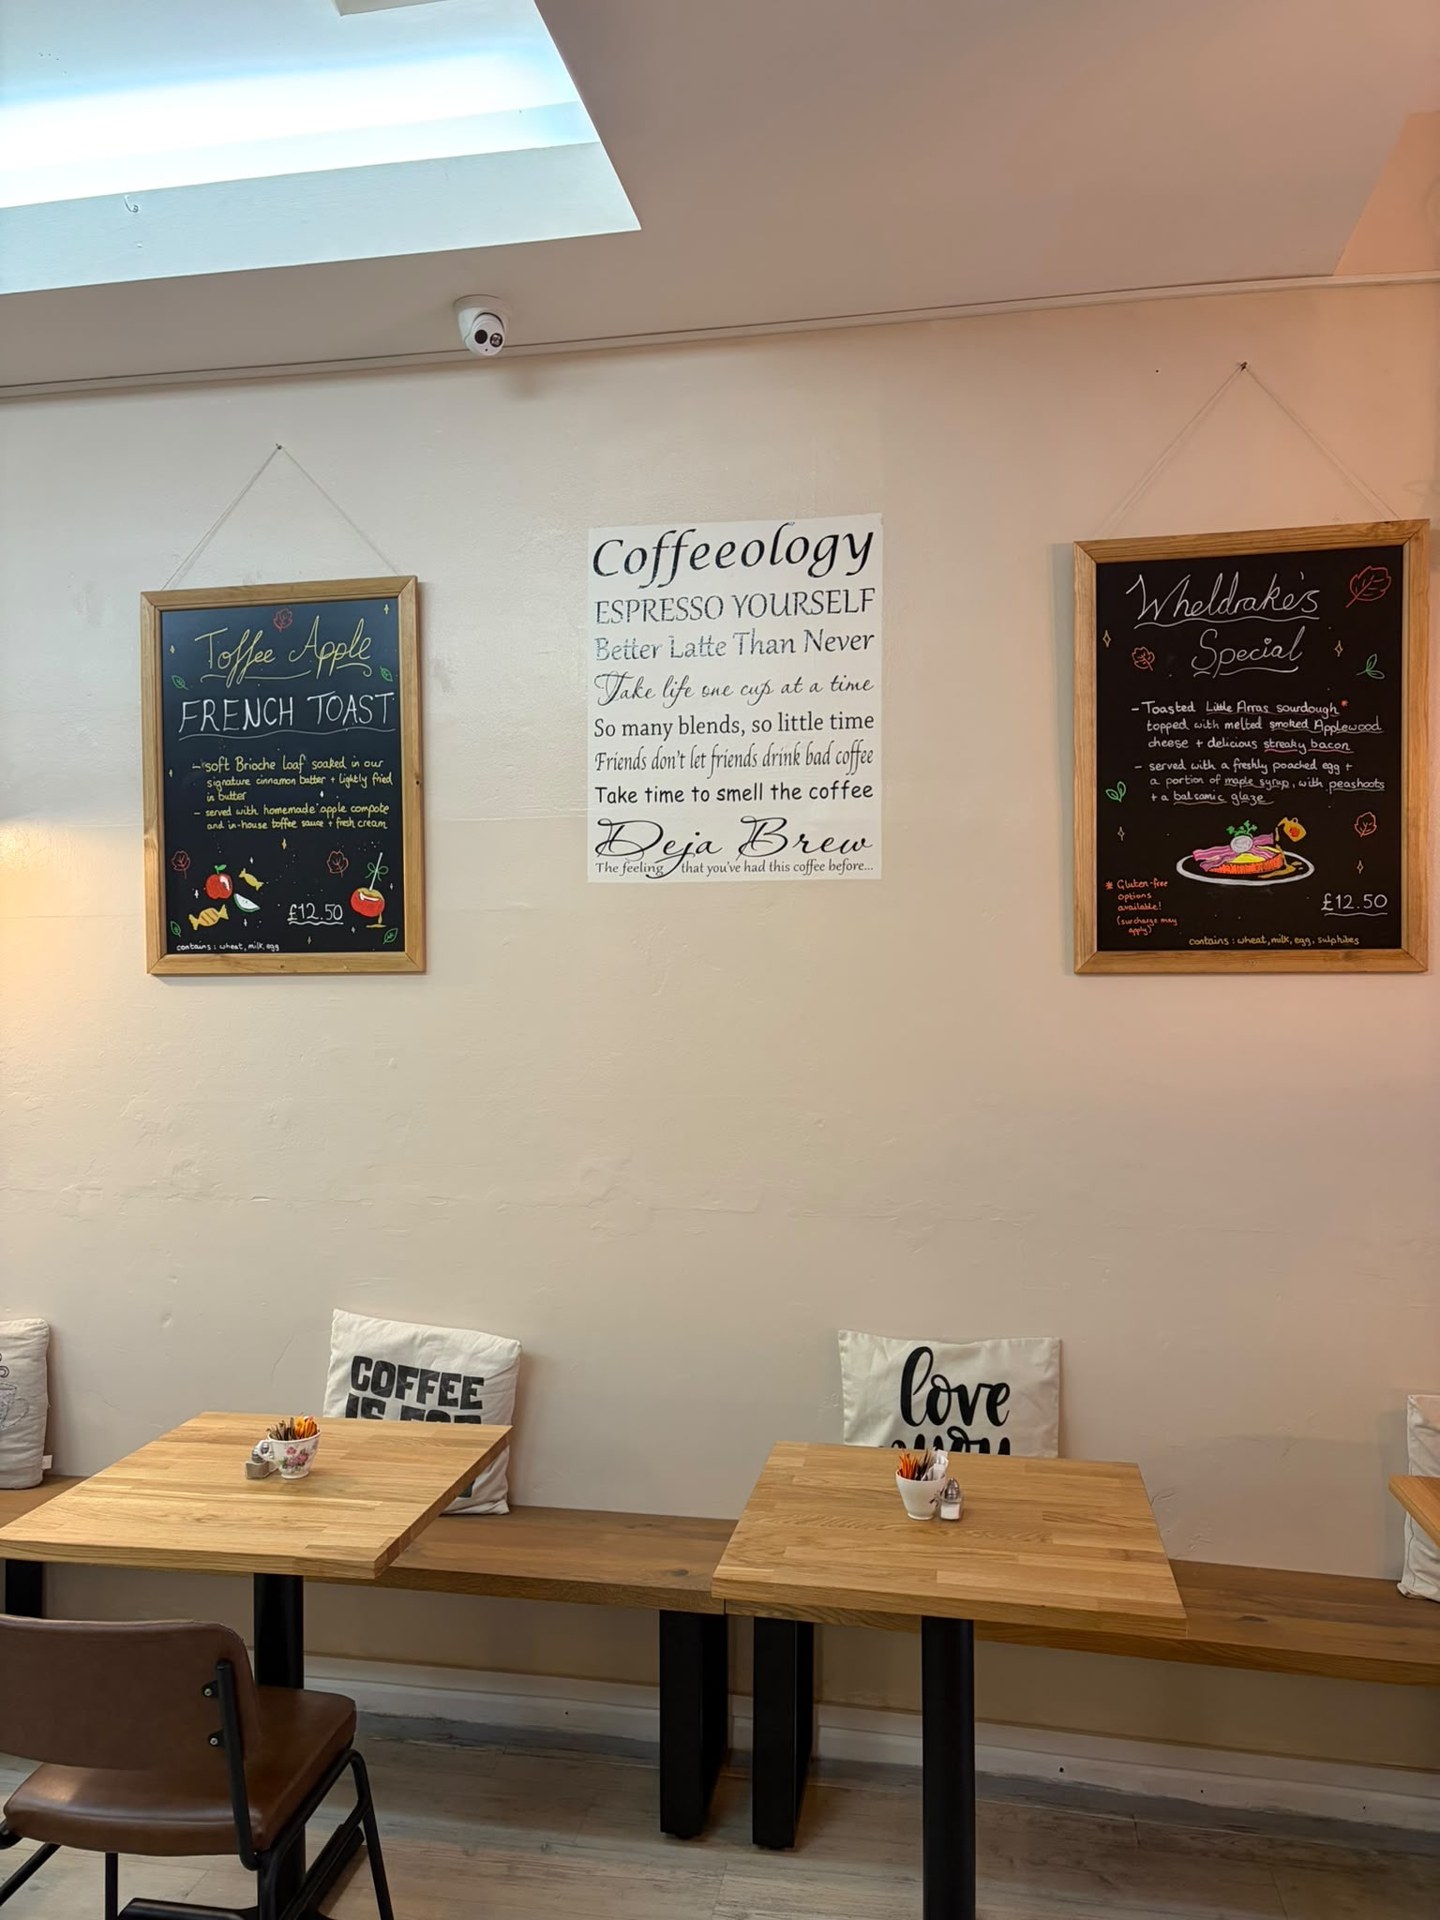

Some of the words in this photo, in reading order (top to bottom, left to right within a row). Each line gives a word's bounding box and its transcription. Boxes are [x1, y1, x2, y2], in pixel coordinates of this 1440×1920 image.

[592, 521, 874, 589] Coffeeology
[595, 595, 724, 624] ESPRESSO
[731, 587, 876, 619] YOURSELF
[1126, 571, 1320, 620] Wheldrake's
[195, 627, 276, 688] Toffee
[288, 615, 371, 679] Apple
[594, 637, 662, 661] Better
[669, 635, 727, 658] Latte
[733, 628, 796, 655] Than
[803, 628, 874, 653] Never
[1191, 626, 1306, 678] Special
[594, 670, 655, 706] Take
[662, 674, 695, 709] life
[701, 686, 734, 697] one
[740, 679, 773, 706] cup
[781, 676, 803, 694] at
[809, 683, 823, 693] a
[830, 675, 874, 692] time
[178, 697, 293, 733] FRENCH
[307, 691, 395, 726] TOAST
[1141, 700, 1196, 714] Toasted
[1206, 700, 1233, 713] Little
[1237, 700, 1268, 713] Arras
[594, 718, 616, 737] So
[622, 721, 673, 741] many
[678, 714, 746, 737] blends,
[751, 718, 772, 733] so
[778, 711, 824, 732] little
[829, 712, 874, 730] time
[1147, 718, 1190, 735] topped
[1194, 719, 1219, 729] with
[1225, 716, 1262, 730] melted
[1269, 718, 1309, 729] smoked
[1314, 715, 1382, 736] Applewood
[1148, 736, 1189, 748] cheese
[1207, 736, 1257, 749] delicious
[1263, 738, 1306, 755] streaky
[1311, 738, 1350, 750] bacon
[205, 756, 230, 773] soft
[235, 756, 276, 772] Brioche
[283, 754, 306, 773] loaf
[312, 756, 347, 770] soaked
[351, 755, 360, 768] in
[594, 746, 647, 772] Friends
[651, 746, 686, 771] don't
[690, 744, 706, 768] let
[706, 743, 758, 779] friends
[762, 742, 800, 767] drink
[805, 740, 831, 766] bad
[835, 739, 874, 775] coffee
[1149, 758, 1186, 771] served
[1191, 760, 1216, 770] with
[1233, 758, 1268, 774] freshly
[1273, 758, 1317, 773] poached
[1322, 762, 1340, 775] egg
[207, 776, 251, 792] signature
[256, 775, 296, 785] cinnamon
[299, 775, 326, 784] batter
[339, 773, 367, 789] lightly
[372, 771, 393, 786] fried
[1166, 774, 1204, 789] portion
[1209, 774, 1221, 784] of
[1225, 776, 1252, 788] maple
[1299, 777, 1323, 787] with
[1329, 778, 1385, 794] peashoots
[207, 792, 214, 802] in
[218, 790, 247, 801] butter
[594, 786, 638, 804] Take
[645, 787, 685, 803] time
[691, 786, 709, 802] to
[716, 782, 763, 801] smell
[771, 782, 802, 800] the
[809, 780, 874, 800] coffee
[1173, 789, 1224, 801] balsamic
[1231, 791, 1263, 806] glaze
[205, 806, 232, 816] served
[236, 805, 258, 815] with
[264, 803, 316, 815] homemade
[320, 802, 347, 818] apple
[350, 802, 389, 818] compote
[207, 821, 224, 830] and
[228, 820, 268, 830] in-house
[271, 817, 297, 830] toffee
[336, 817, 355, 829] fresh
[357, 820, 387, 829] cream
[594, 817, 723, 880] Deja
[736, 815, 873, 861] Brew
[595, 863, 619, 873] The
[620, 858, 664, 876] feeling
[682, 861, 704, 873] that
[706, 860, 741, 877] you've
[743, 859, 765, 872] had
[769, 858, 790, 872] this
[793, 858, 825, 876] coffee
[828, 858, 874, 875] before...
[1118, 892, 1152, 903] options
[1118, 901, 1161, 911] available!
[1321, 893, 1388, 912] £12.50
[287, 903, 343, 921] £12.50
[1161, 918, 1178, 926] may
[266, 944, 279, 952] egg
[351, 1355, 485, 1410] COFFEE
[901, 1346, 1010, 1427] love
